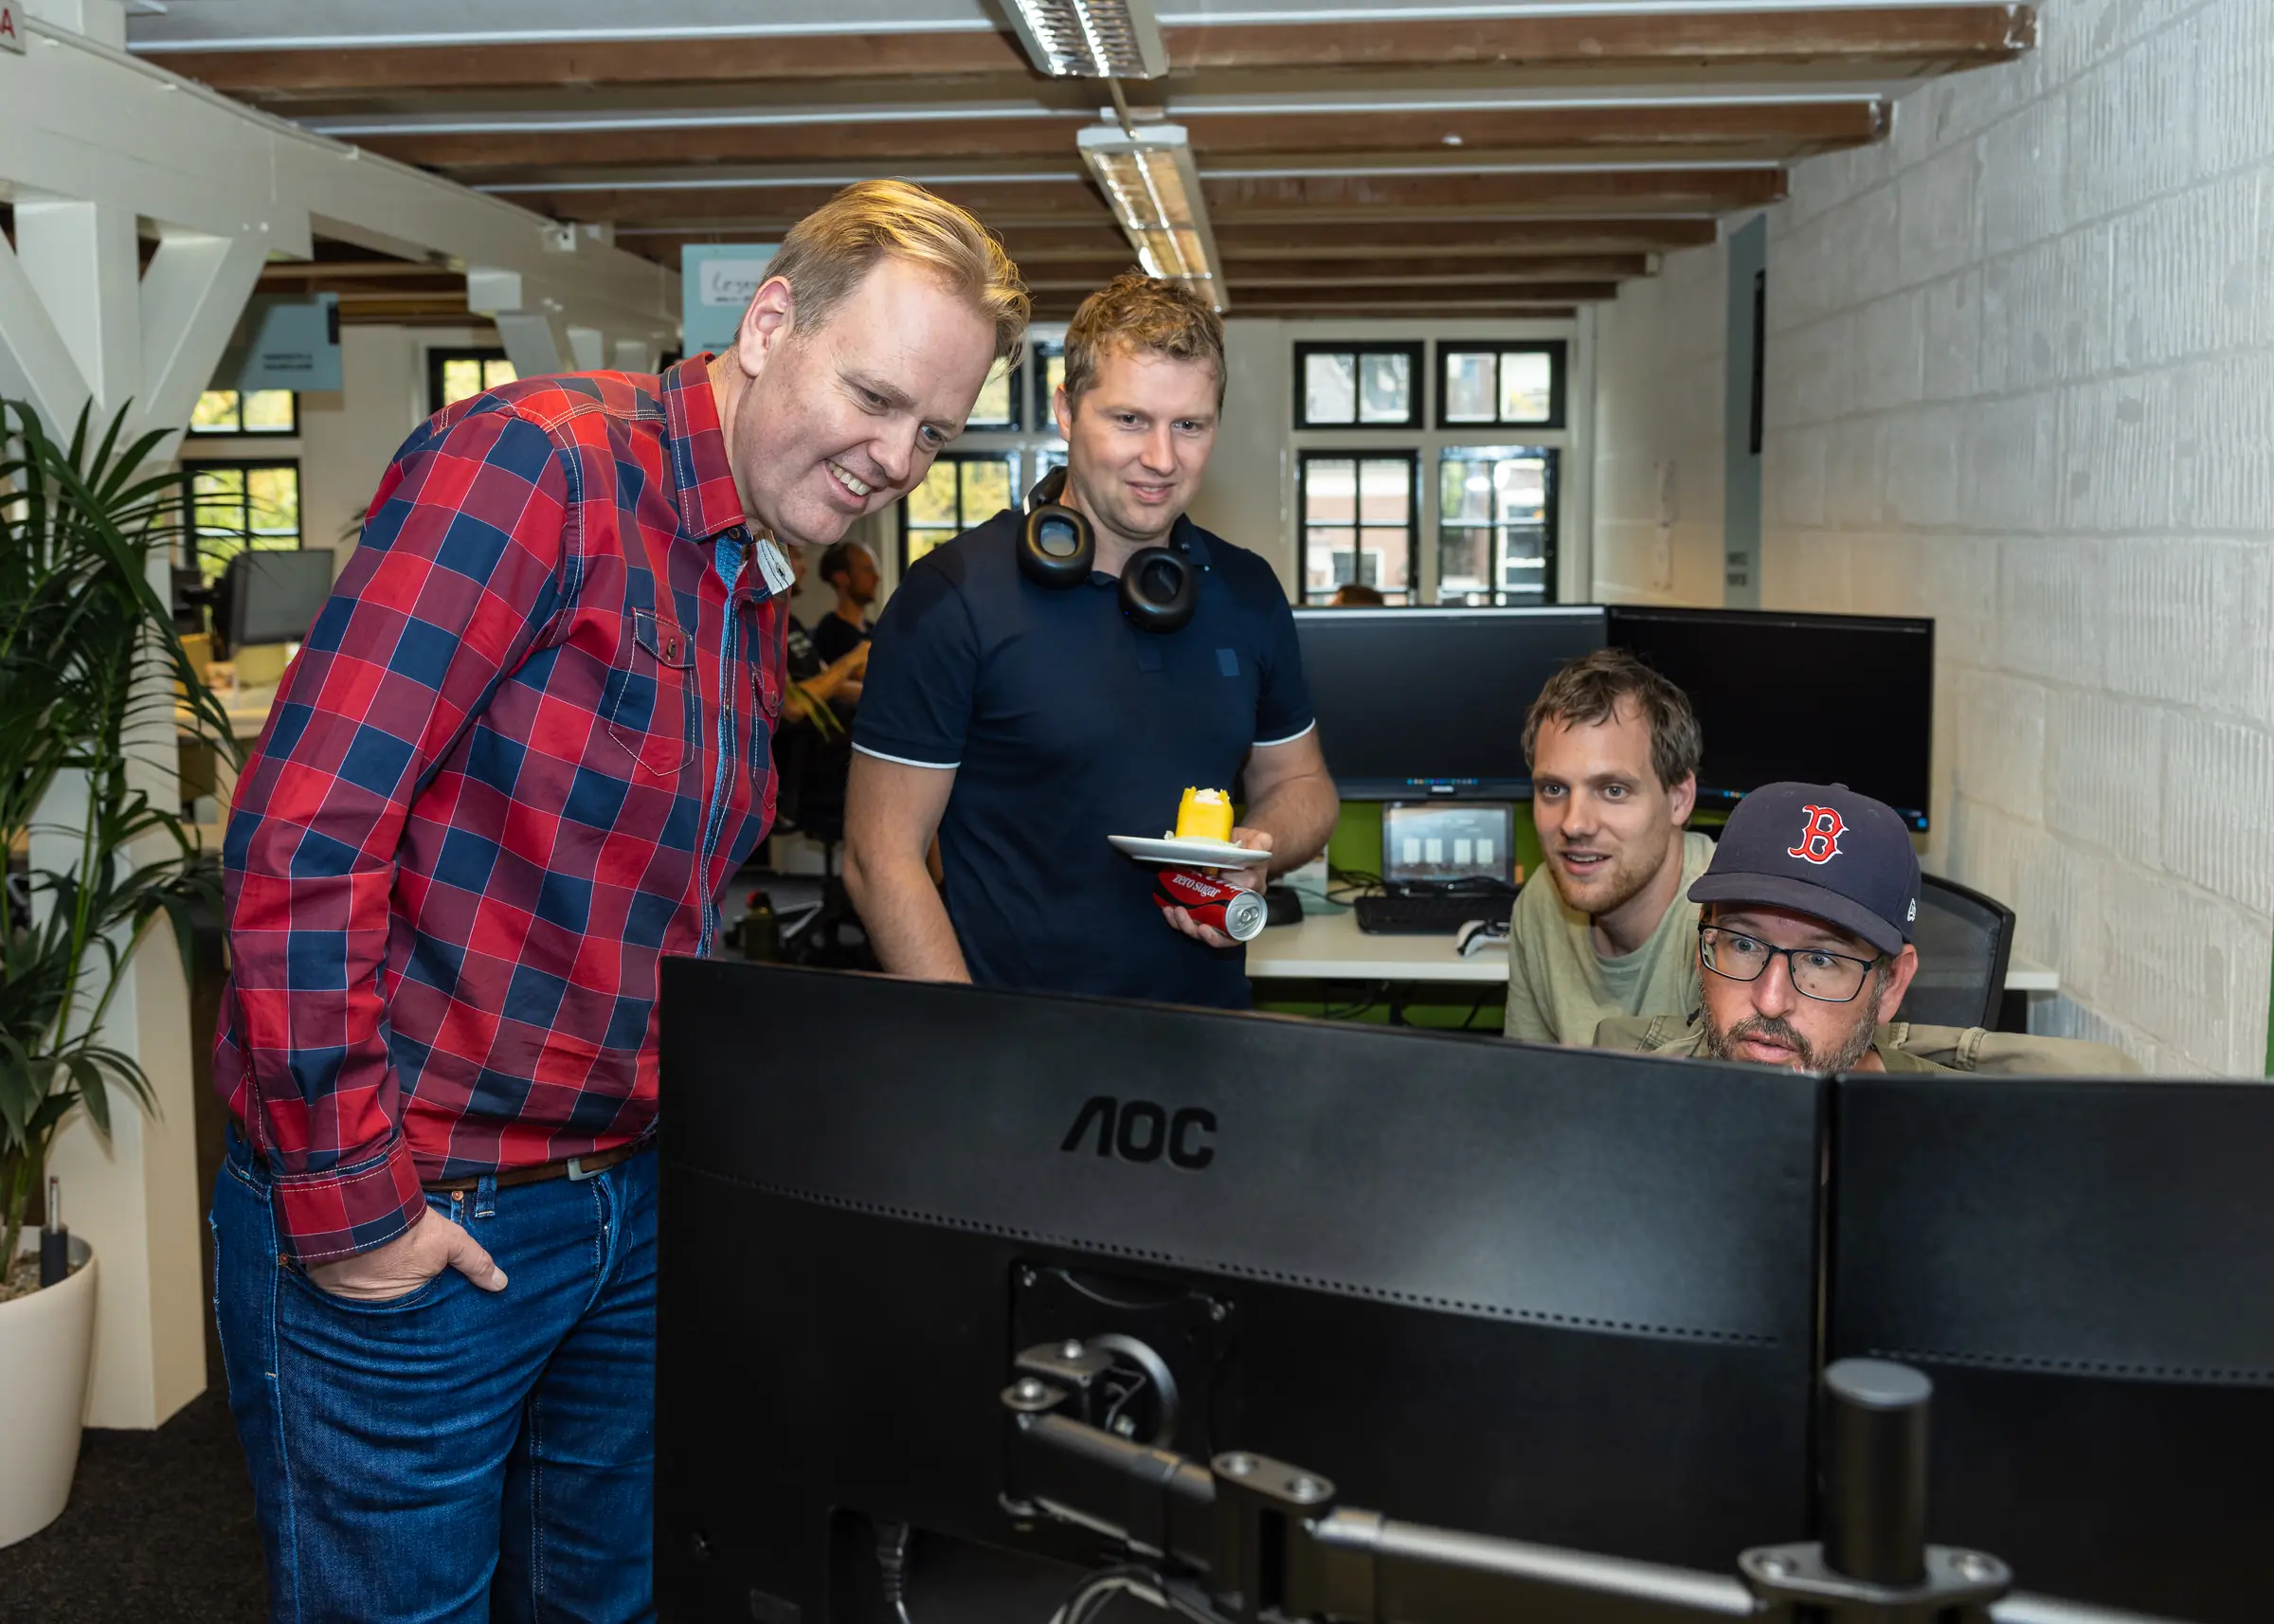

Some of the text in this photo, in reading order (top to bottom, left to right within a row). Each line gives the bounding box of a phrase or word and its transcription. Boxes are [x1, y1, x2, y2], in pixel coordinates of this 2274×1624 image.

[1787, 804, 1850, 864] B
[1172, 874, 1195, 889] zero
[1192, 881, 1221, 898] sugar
[1059, 1095, 1218, 1169] AOC
